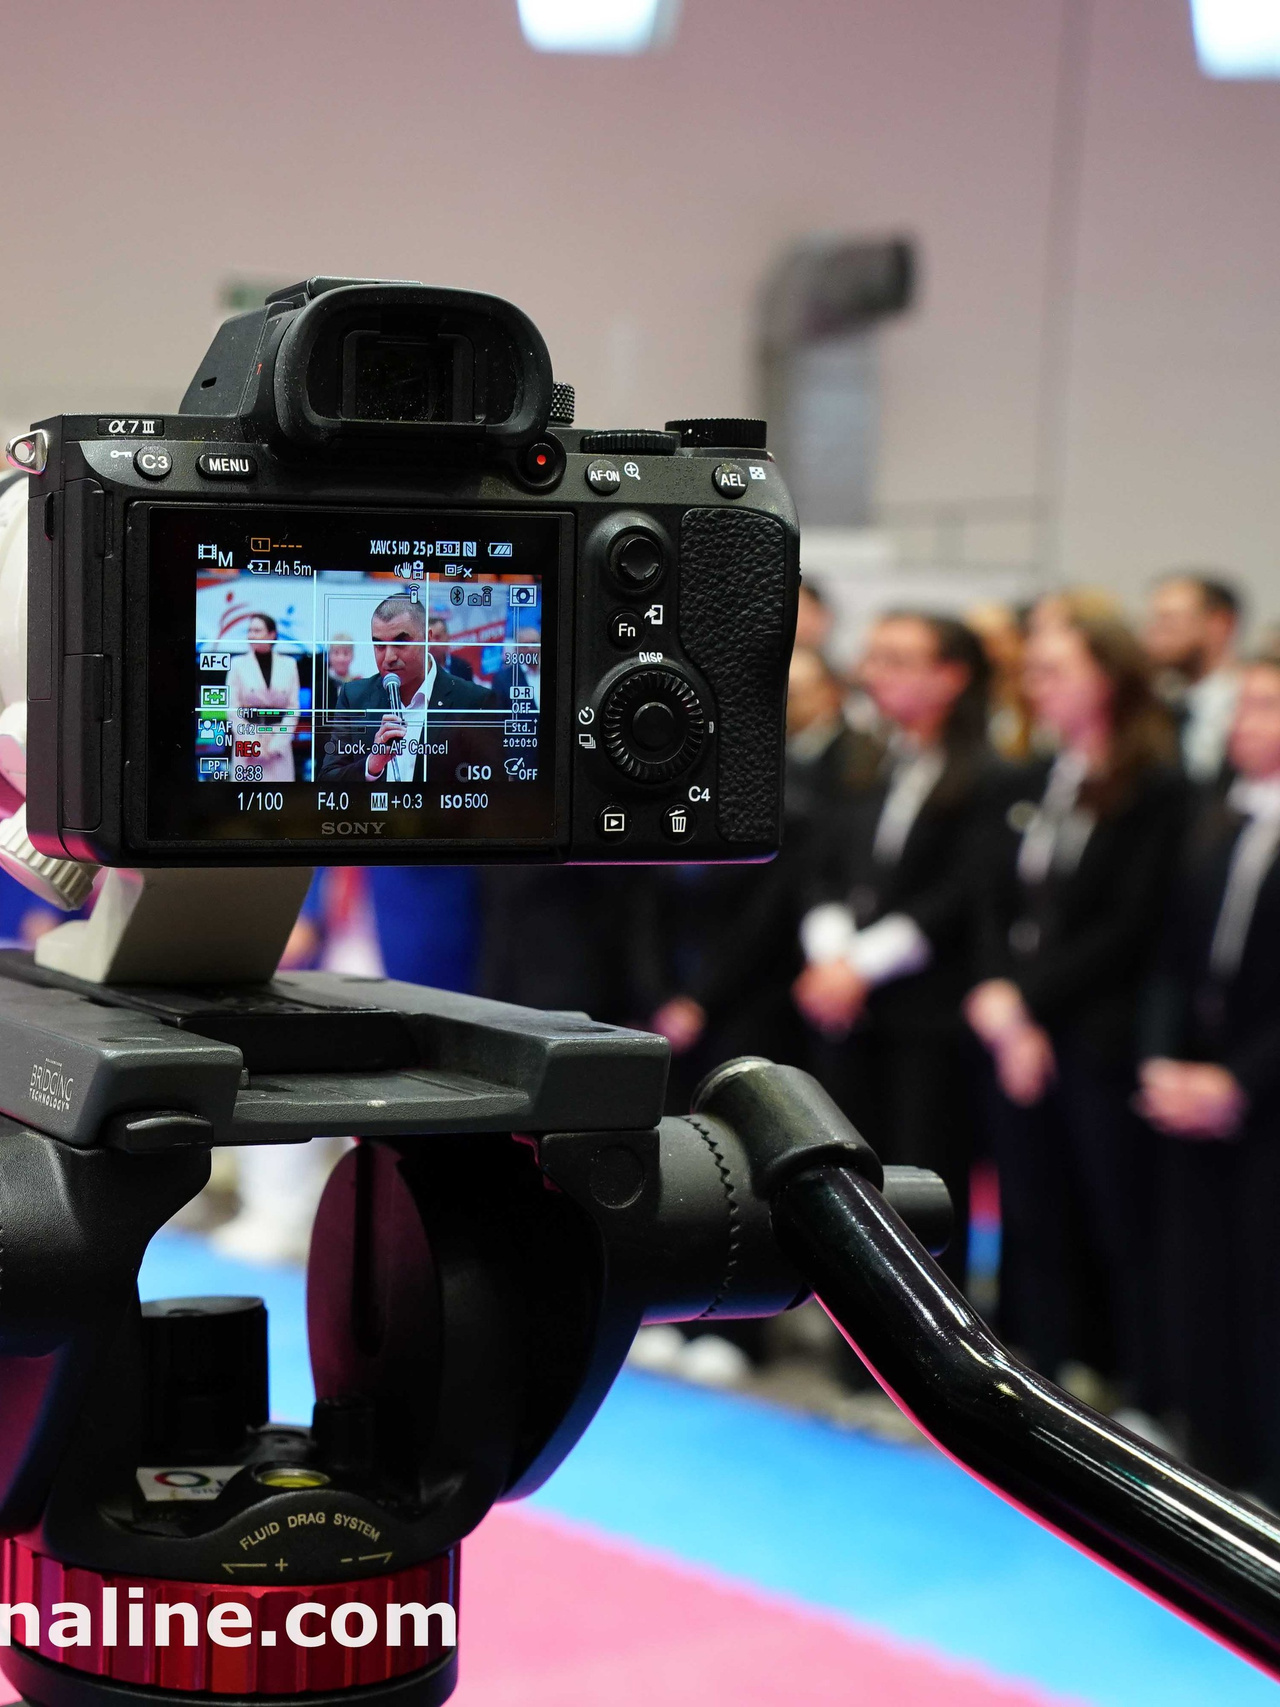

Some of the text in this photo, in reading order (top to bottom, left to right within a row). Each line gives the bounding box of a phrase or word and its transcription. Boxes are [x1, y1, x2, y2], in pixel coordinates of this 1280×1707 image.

[141, 454, 168, 469] C3
[208, 458, 250, 472] MENU
[590, 470, 621, 482] AF-ON
[720, 473, 746, 487] AEL
[399, 541, 410, 555] HD
[413, 541, 434, 557] 25p
[442, 544, 453, 554] 50
[218, 551, 233, 567] M
[274, 560, 290, 576] 4h
[293, 560, 312, 576] 5m
[618, 623, 636, 637] Fn
[202, 655, 228, 668] AF-C
[505, 653, 539, 665] 3800K
[639, 652, 663, 663] DISP
[513, 687, 531, 698] D-R
[512, 702, 532, 713] OFF
[218, 721, 233, 733] AF
[215, 735, 233, 747] ON
[337, 740, 449, 755] Lock-on AF Cancel
[235, 741, 261, 757] REC
[208, 760, 220, 770] PP
[213, 771, 229, 780] OFF
[235, 765, 263, 781] 8:38
[467, 765, 492, 780] ISO
[518, 769, 538, 780] OFF
[688, 786, 711, 802] C4
[237, 792, 284, 811] 1/100
[318, 792, 349, 810] F4.0
[440, 794, 463, 809] ISO
[464, 794, 489, 809] 500
[321, 821, 387, 835] SONY
[30, 1063, 74, 1102] BRIDGING
[239, 1511, 381, 1550] FLUID DRAG SYSTEM
